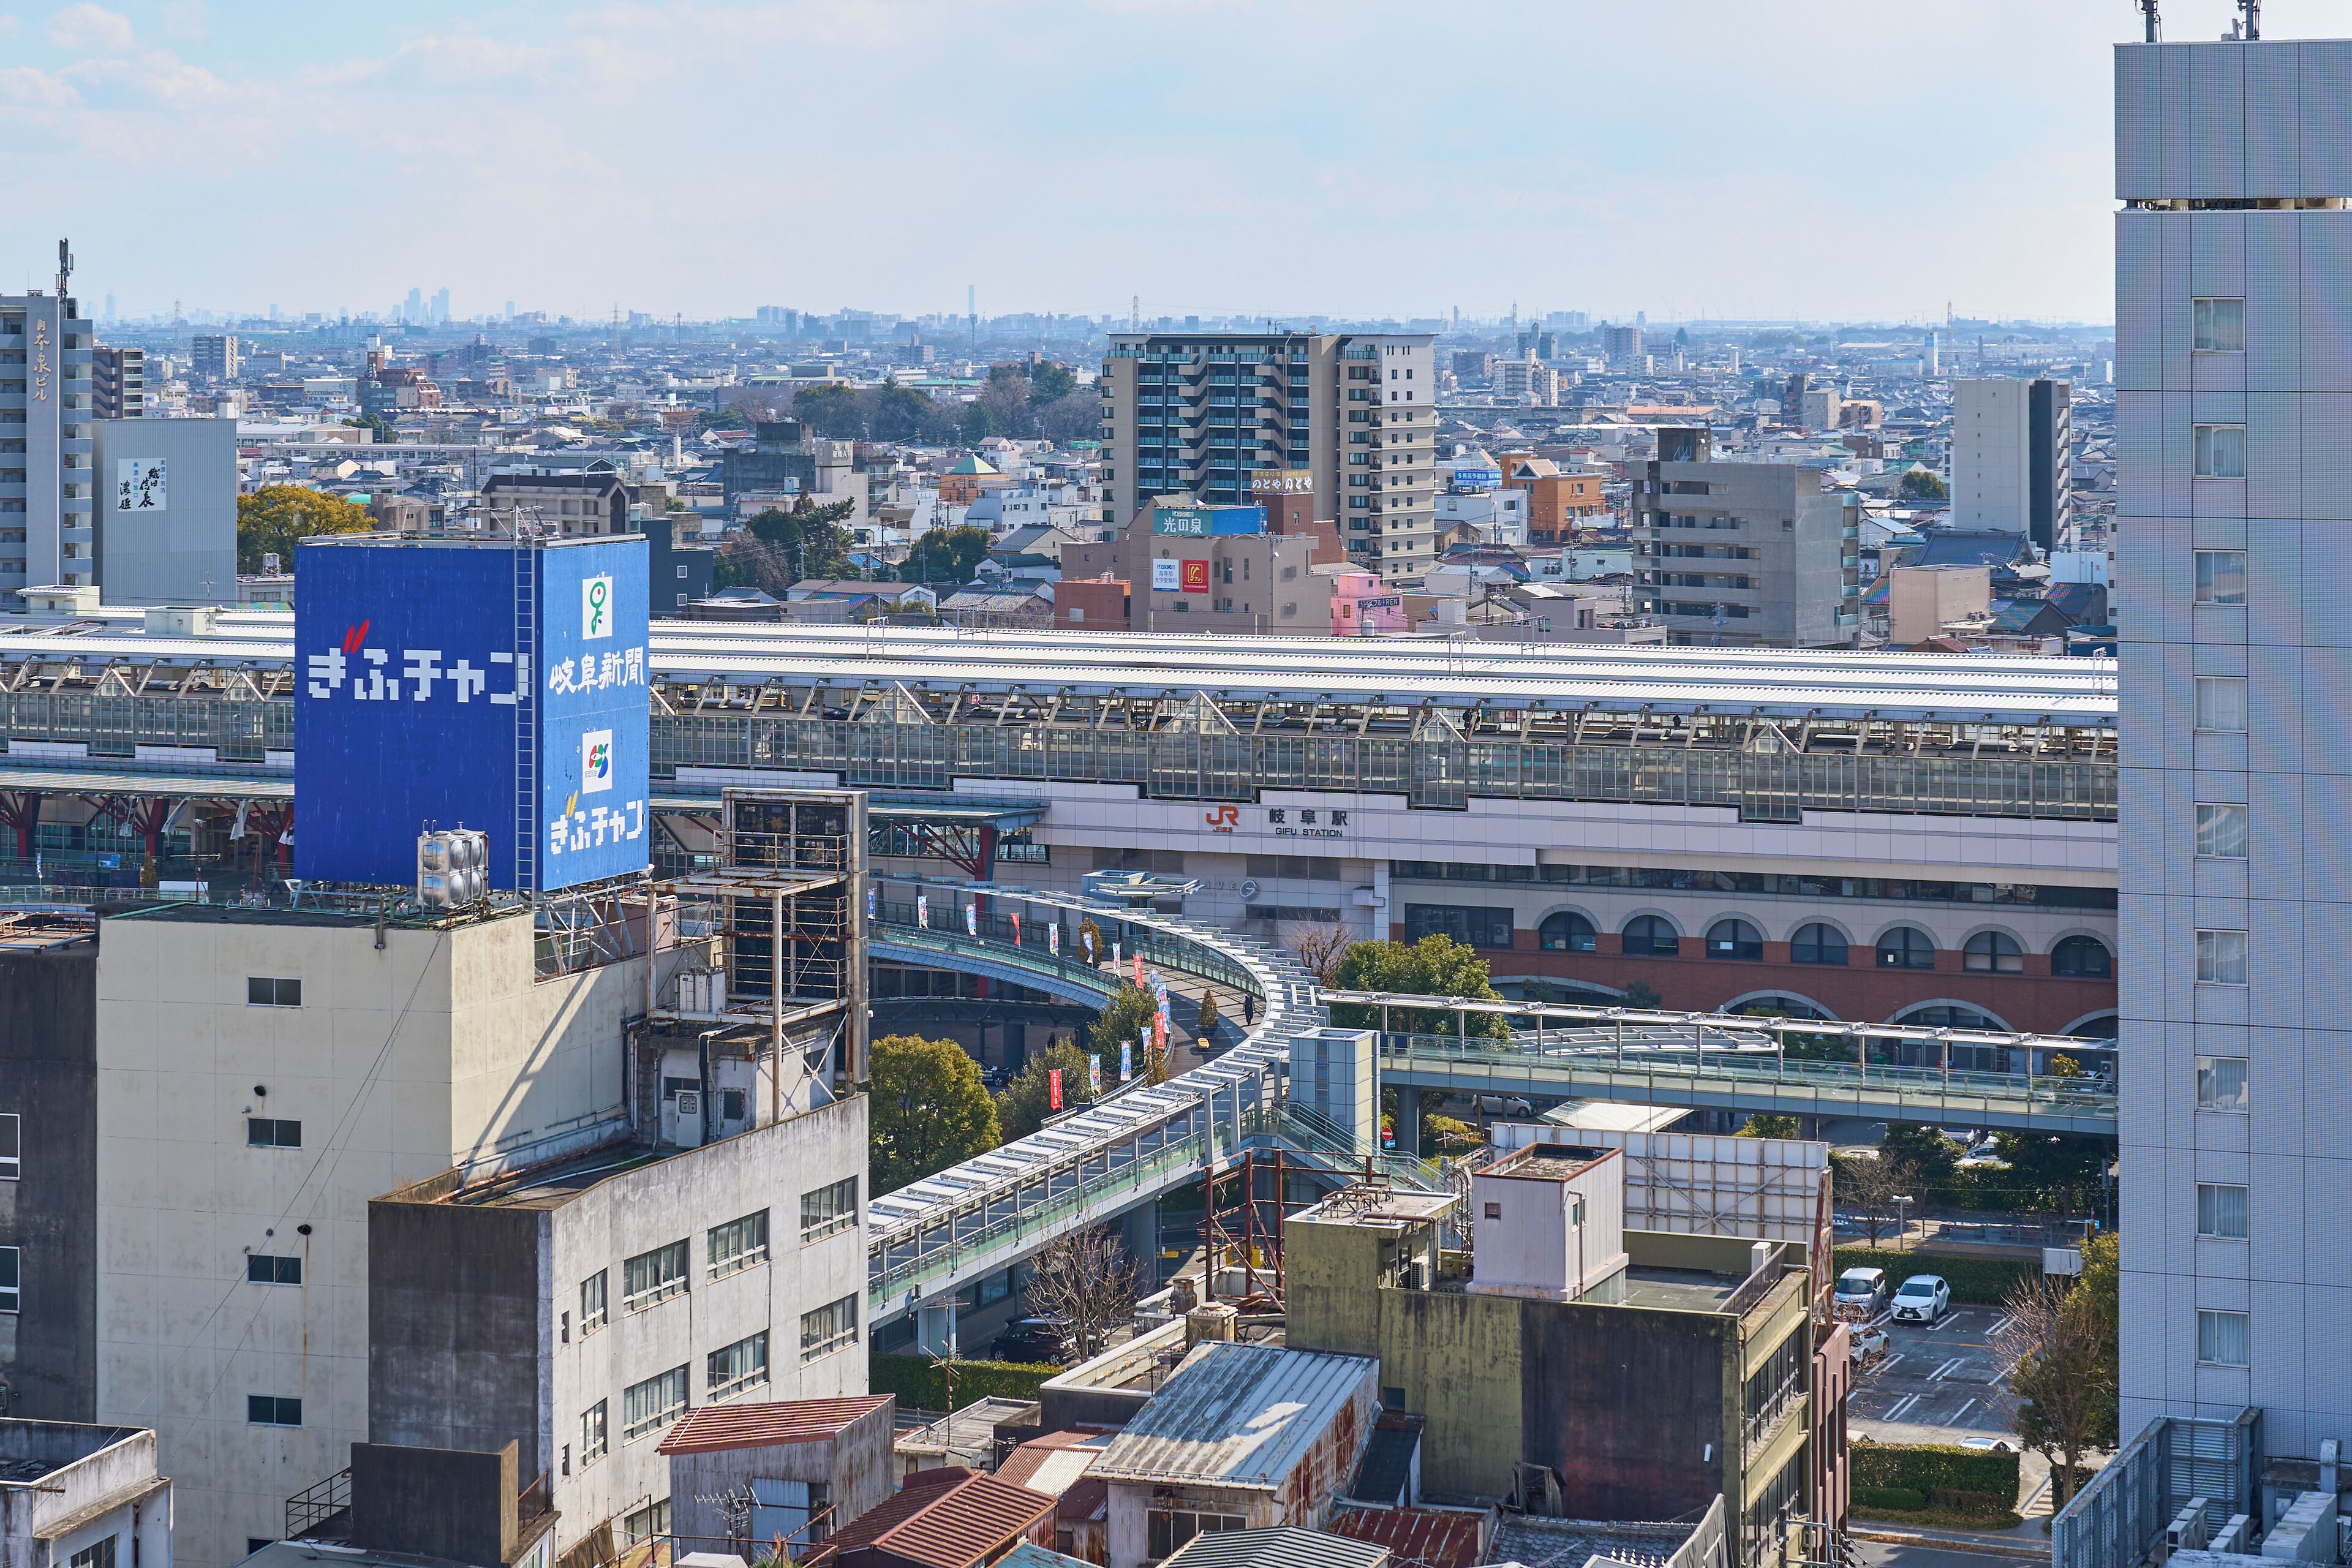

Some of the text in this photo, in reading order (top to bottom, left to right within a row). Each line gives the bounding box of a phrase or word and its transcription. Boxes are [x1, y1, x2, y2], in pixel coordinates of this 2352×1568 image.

[32, 318, 52, 402] 日本泉ビル
[1253, 478, 1281, 489] のとや
[1285, 476, 1312, 490] のとや
[1163, 517, 1202, 533] 光の泉
[309, 619, 529, 704] ぎふチャン
[549, 646, 644, 695] 岐阜新聞
[551, 790, 643, 855] ぎふチャン
[1206, 805, 1239, 826] JR
[1269, 808, 1348, 826] 岐阜駅
[1302, 828, 1343, 837] STATION
